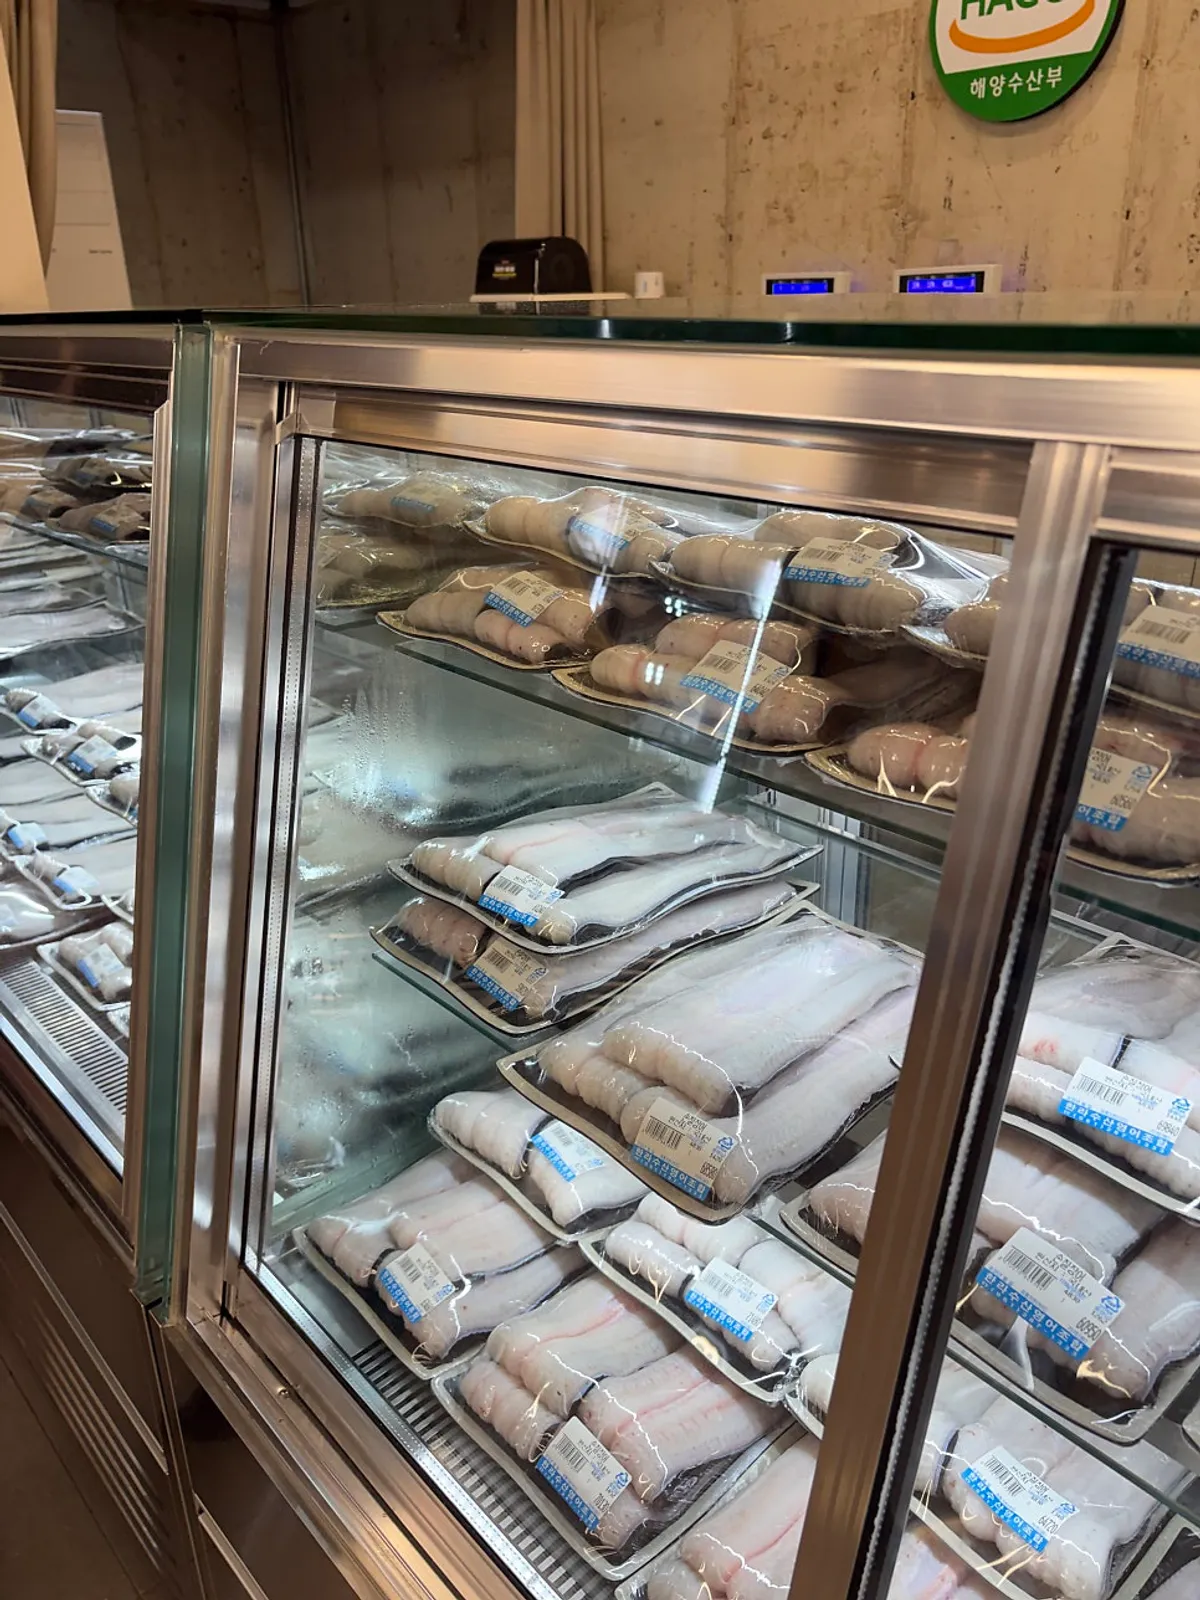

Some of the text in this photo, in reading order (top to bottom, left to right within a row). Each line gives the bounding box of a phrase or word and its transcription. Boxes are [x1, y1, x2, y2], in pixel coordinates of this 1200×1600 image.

[970, 66, 1063, 98] 해양수산부
[1064, 1102, 1168, 1149] 한라수산영어조합
[634, 1148, 706, 1194] 한라수산영어조합
[985, 1272, 1084, 1352] 한라수산영어조합
[1075, 1316, 1102, 1341] 60950
[967, 1471, 1044, 1545] 한라수산영어조합
